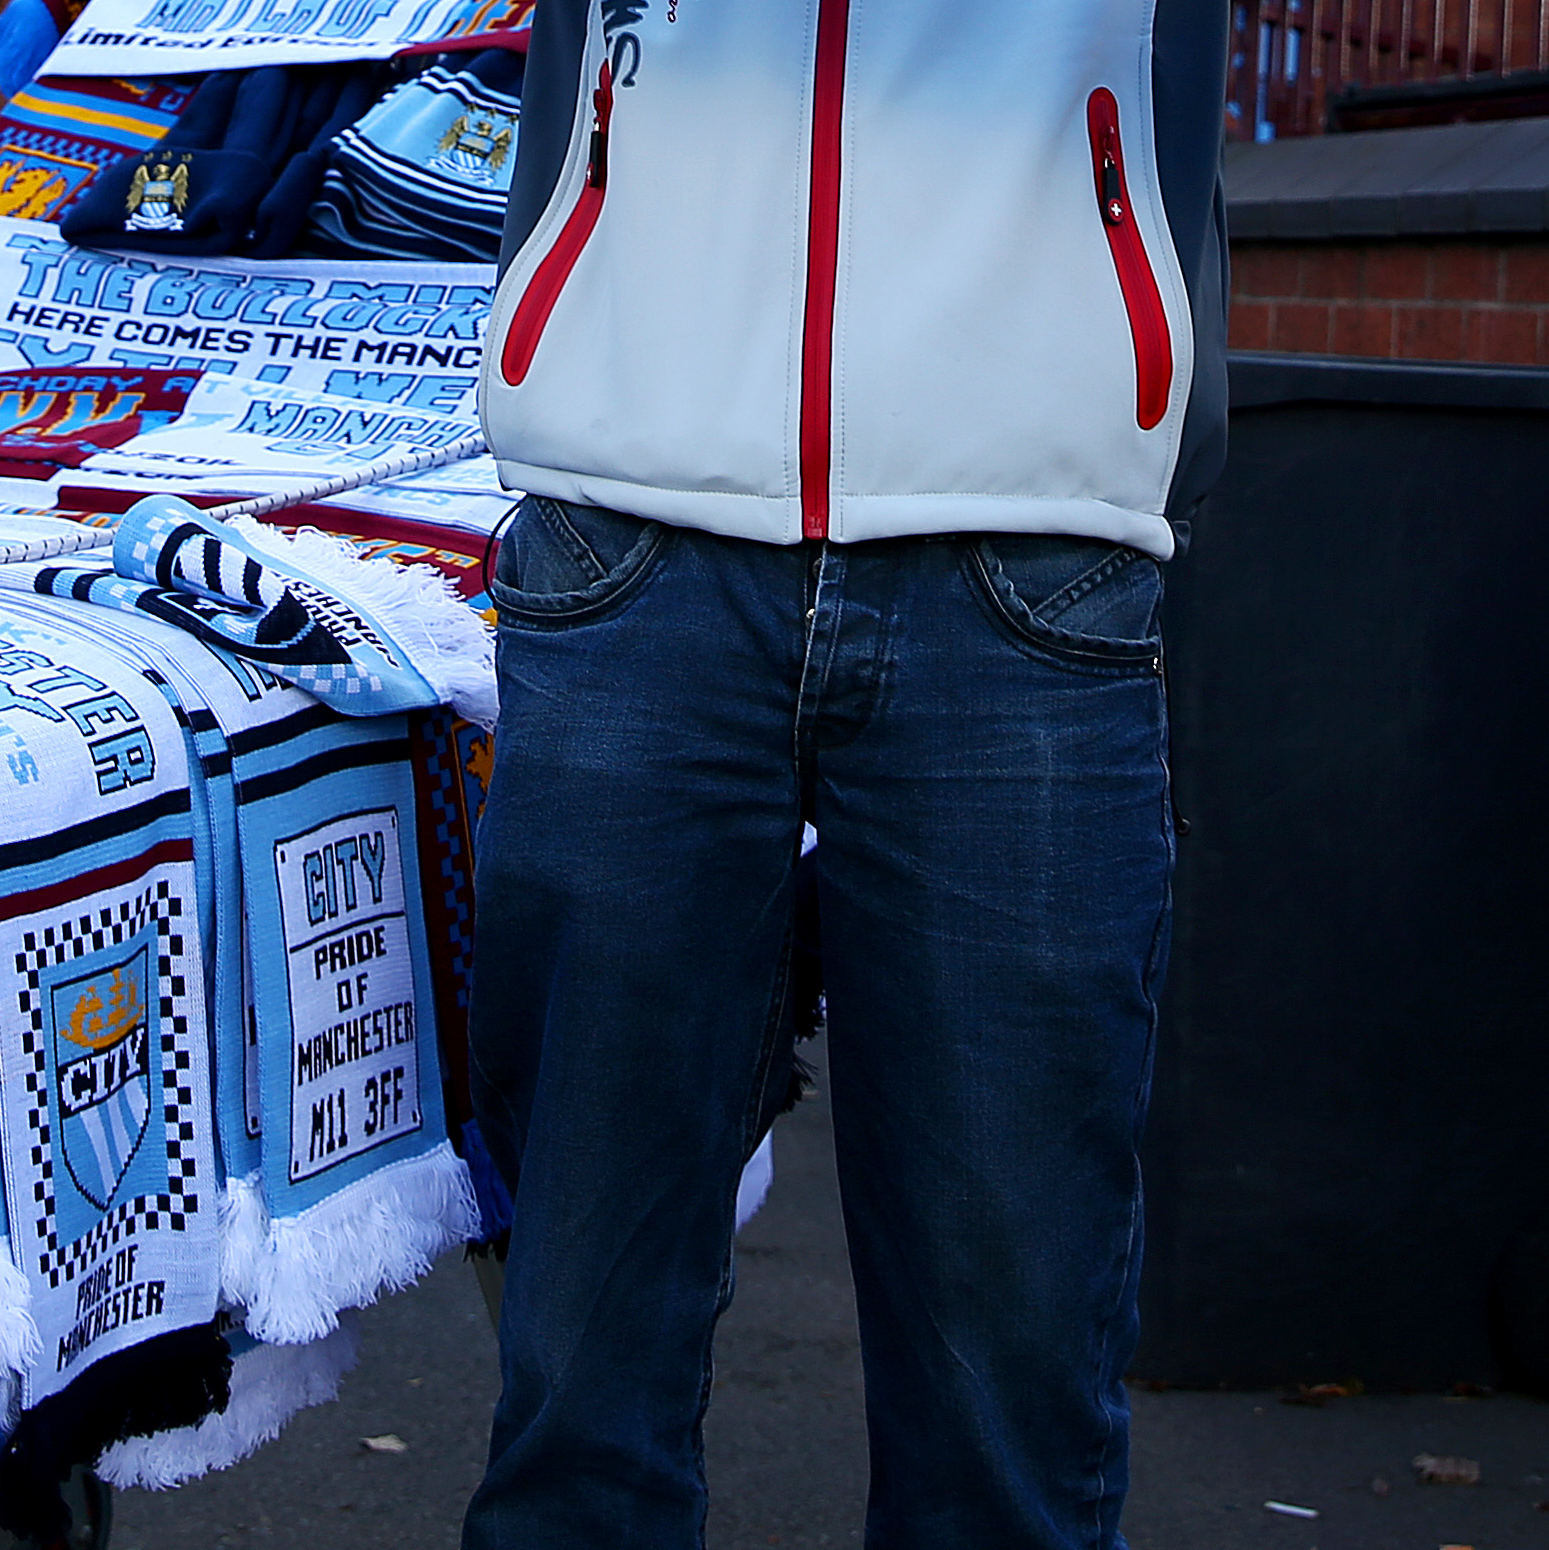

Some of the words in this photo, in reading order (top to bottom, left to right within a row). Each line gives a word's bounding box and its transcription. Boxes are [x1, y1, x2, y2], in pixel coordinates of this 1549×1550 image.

[6, 302, 110, 338] HERE
[115, 320, 253, 354] COMES
[265, 331, 347, 362] THE
[19, 251, 147, 313] THE
[144, 274, 492, 341] BULLOCK
[304, 830, 386, 928] CITY
[314, 925, 388, 980] PRIDE
[336, 975, 369, 1013] OF
[58, 1027, 148, 1113] CITY
[297, 1001, 415, 1087] MANCHESTER
[308, 1087, 349, 1163] M11
[363, 1067, 405, 1137] 3FF
[56, 1279, 166, 1372] MANCHESTER
[75, 1256, 114, 1321] PRIDE
[114, 1245, 139, 1289] OF
